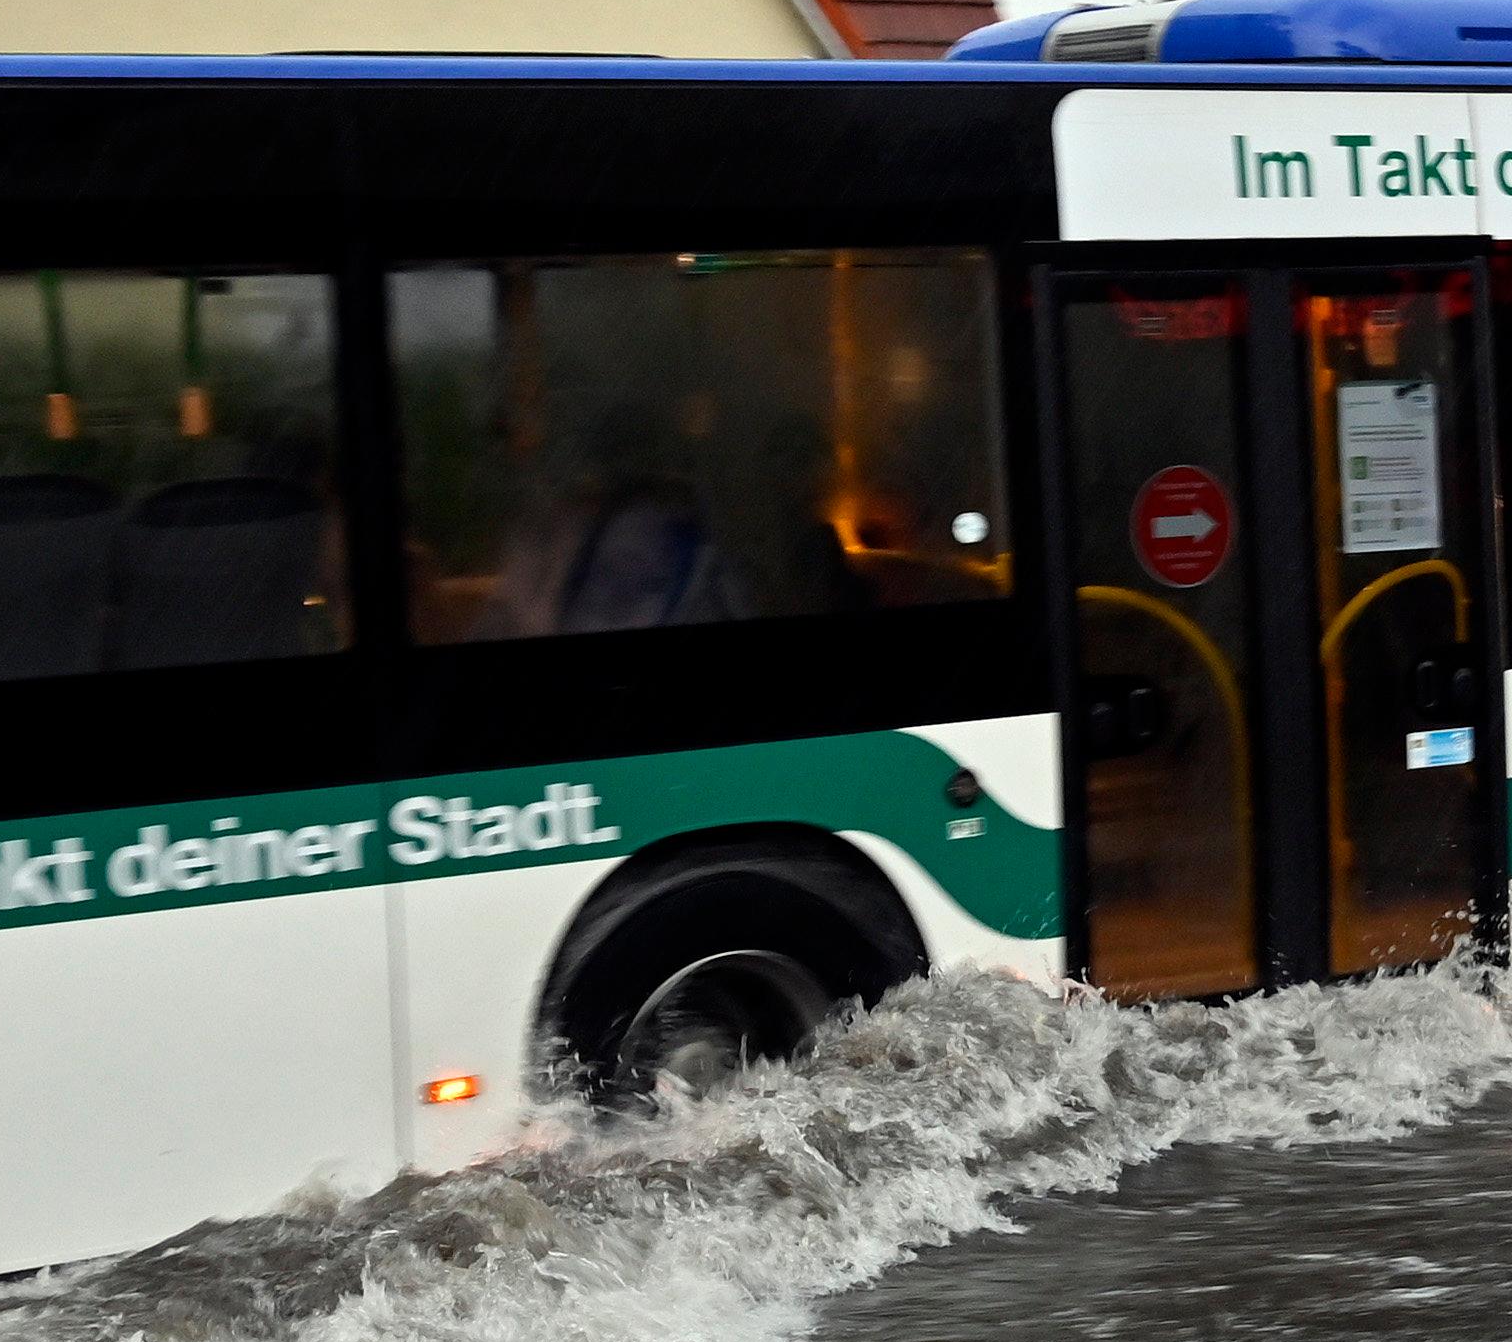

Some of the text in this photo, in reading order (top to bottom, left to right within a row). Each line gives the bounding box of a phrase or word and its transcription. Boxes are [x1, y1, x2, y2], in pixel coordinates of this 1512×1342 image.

[1231, 134, 1316, 198] Im
[1333, 134, 1478, 197] Takt
[106, 817, 377, 898] deiner
[388, 782, 622, 865] Stadt.
